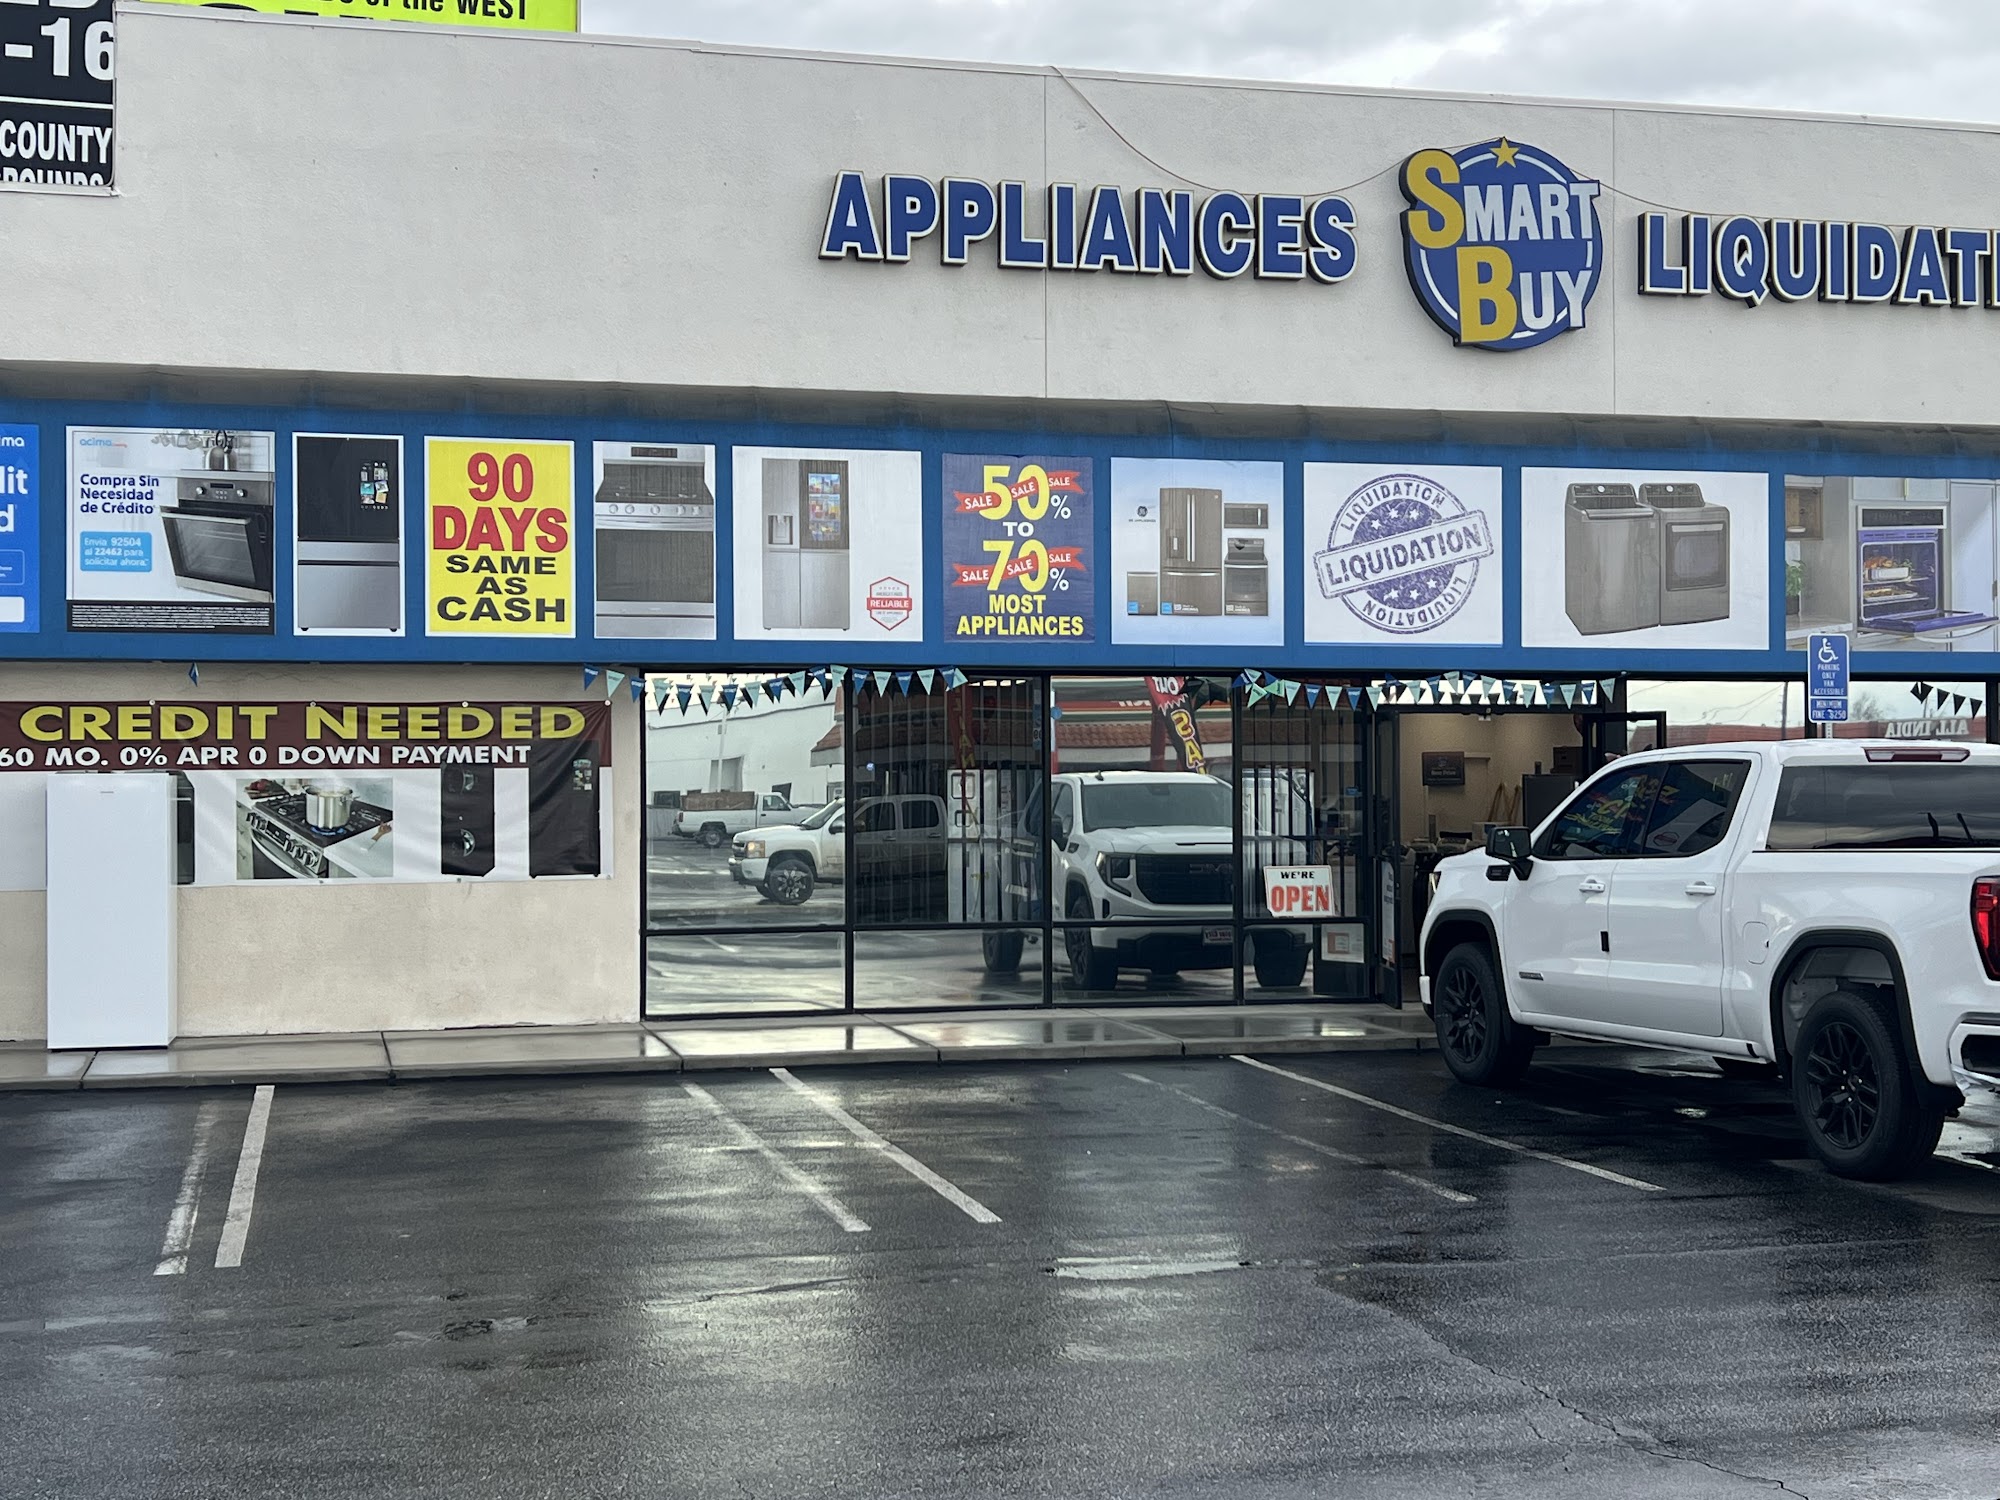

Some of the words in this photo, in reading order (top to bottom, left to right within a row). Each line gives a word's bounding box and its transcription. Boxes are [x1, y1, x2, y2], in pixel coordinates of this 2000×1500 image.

[0, 119, 113, 163] COUNTY
[1405, 149, 1600, 249] SMART
[818, 169, 1358, 284] APPLIANCES
[1456, 245, 1593, 343] BUY
[80, 474, 135, 488] Compra
[139, 475, 160, 487] Sin
[467, 452, 534, 502] 90
[81, 488, 154, 500] Necesidad
[964, 495, 993, 510] SALE
[1011, 481, 1036, 498] SALE
[1048, 477, 1071, 487] SALE
[80, 502, 98, 513] de
[101, 502, 153, 514] Crédito
[1340, 481, 1445, 532] LIQUIDATION
[432, 505, 568, 553] DAYS
[1002, 521, 1035, 537] TO
[110, 537, 141, 547] 92504
[445, 554, 557, 574] SAME
[1325, 523, 1483, 586] LIQUIDATION
[961, 569, 989, 582] SALE
[1006, 558, 1034, 576] SALE
[1049, 553, 1072, 563] SALE
[475, 576, 528, 595] AS
[437, 596, 565, 622] CASH
[870, 600, 909, 608] RELIABLE
[988, 594, 1047, 614] MOST
[1362, 576, 1467, 626] LIQUIDATION
[956, 615, 1084, 636] APPLIANCES
[1817, 663, 1840, 671] PARKING
[1821, 671, 1836, 680] ONLY
[1813, 687, 1844, 696] ACCESSIBLE
[19, 705, 278, 742] CREDIT
[305, 705, 586, 740] NEEDED
[1812, 710, 1826, 720] FINE
[45, 747, 109, 767] MO.
[119, 747, 168, 766] 0%
[176, 746, 239, 766] APR
[248, 746, 268, 766] 0
[278, 745, 380, 766] DOWN
[391, 745, 531, 765] PAYMENT
[1280, 870, 1315, 880] WE'RE
[1270, 884, 1330, 912] OPEN
